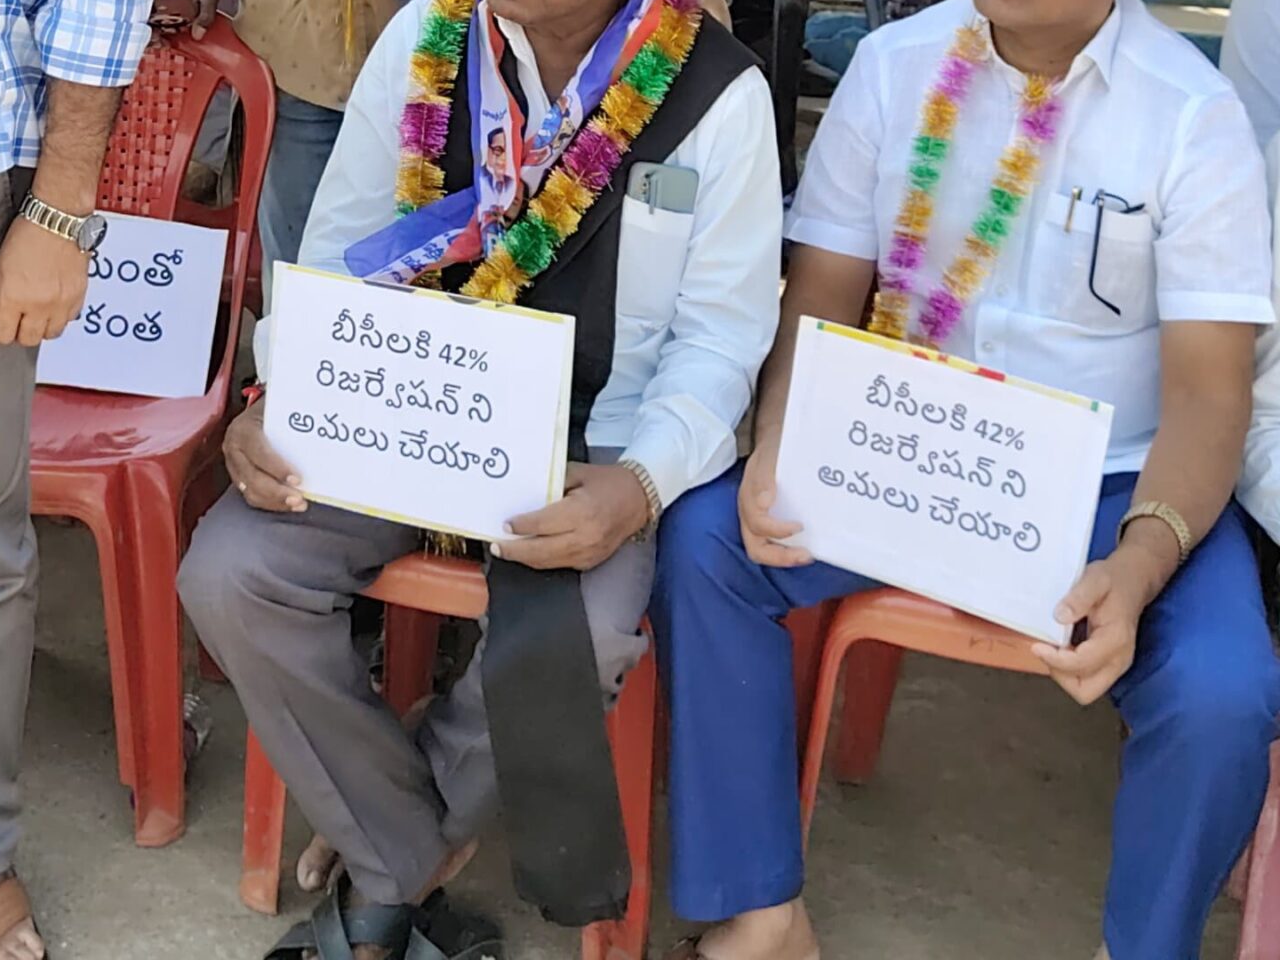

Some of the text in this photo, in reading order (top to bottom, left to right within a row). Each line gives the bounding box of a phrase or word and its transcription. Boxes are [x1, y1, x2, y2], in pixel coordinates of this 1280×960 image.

[76, 303, 162, 341] కంత
[332, 308, 489, 373] బీసీలకి 42%
[316, 360, 493, 424] రిజర్వేషన్ ని
[865, 375, 1026, 452] బీసీలకి 42%
[288, 410, 510, 479] అమలు చేయాలి
[848, 420, 1027, 499] రిజర్వేషన్ ని
[818, 463, 1042, 553] అమలు చేయాలి
